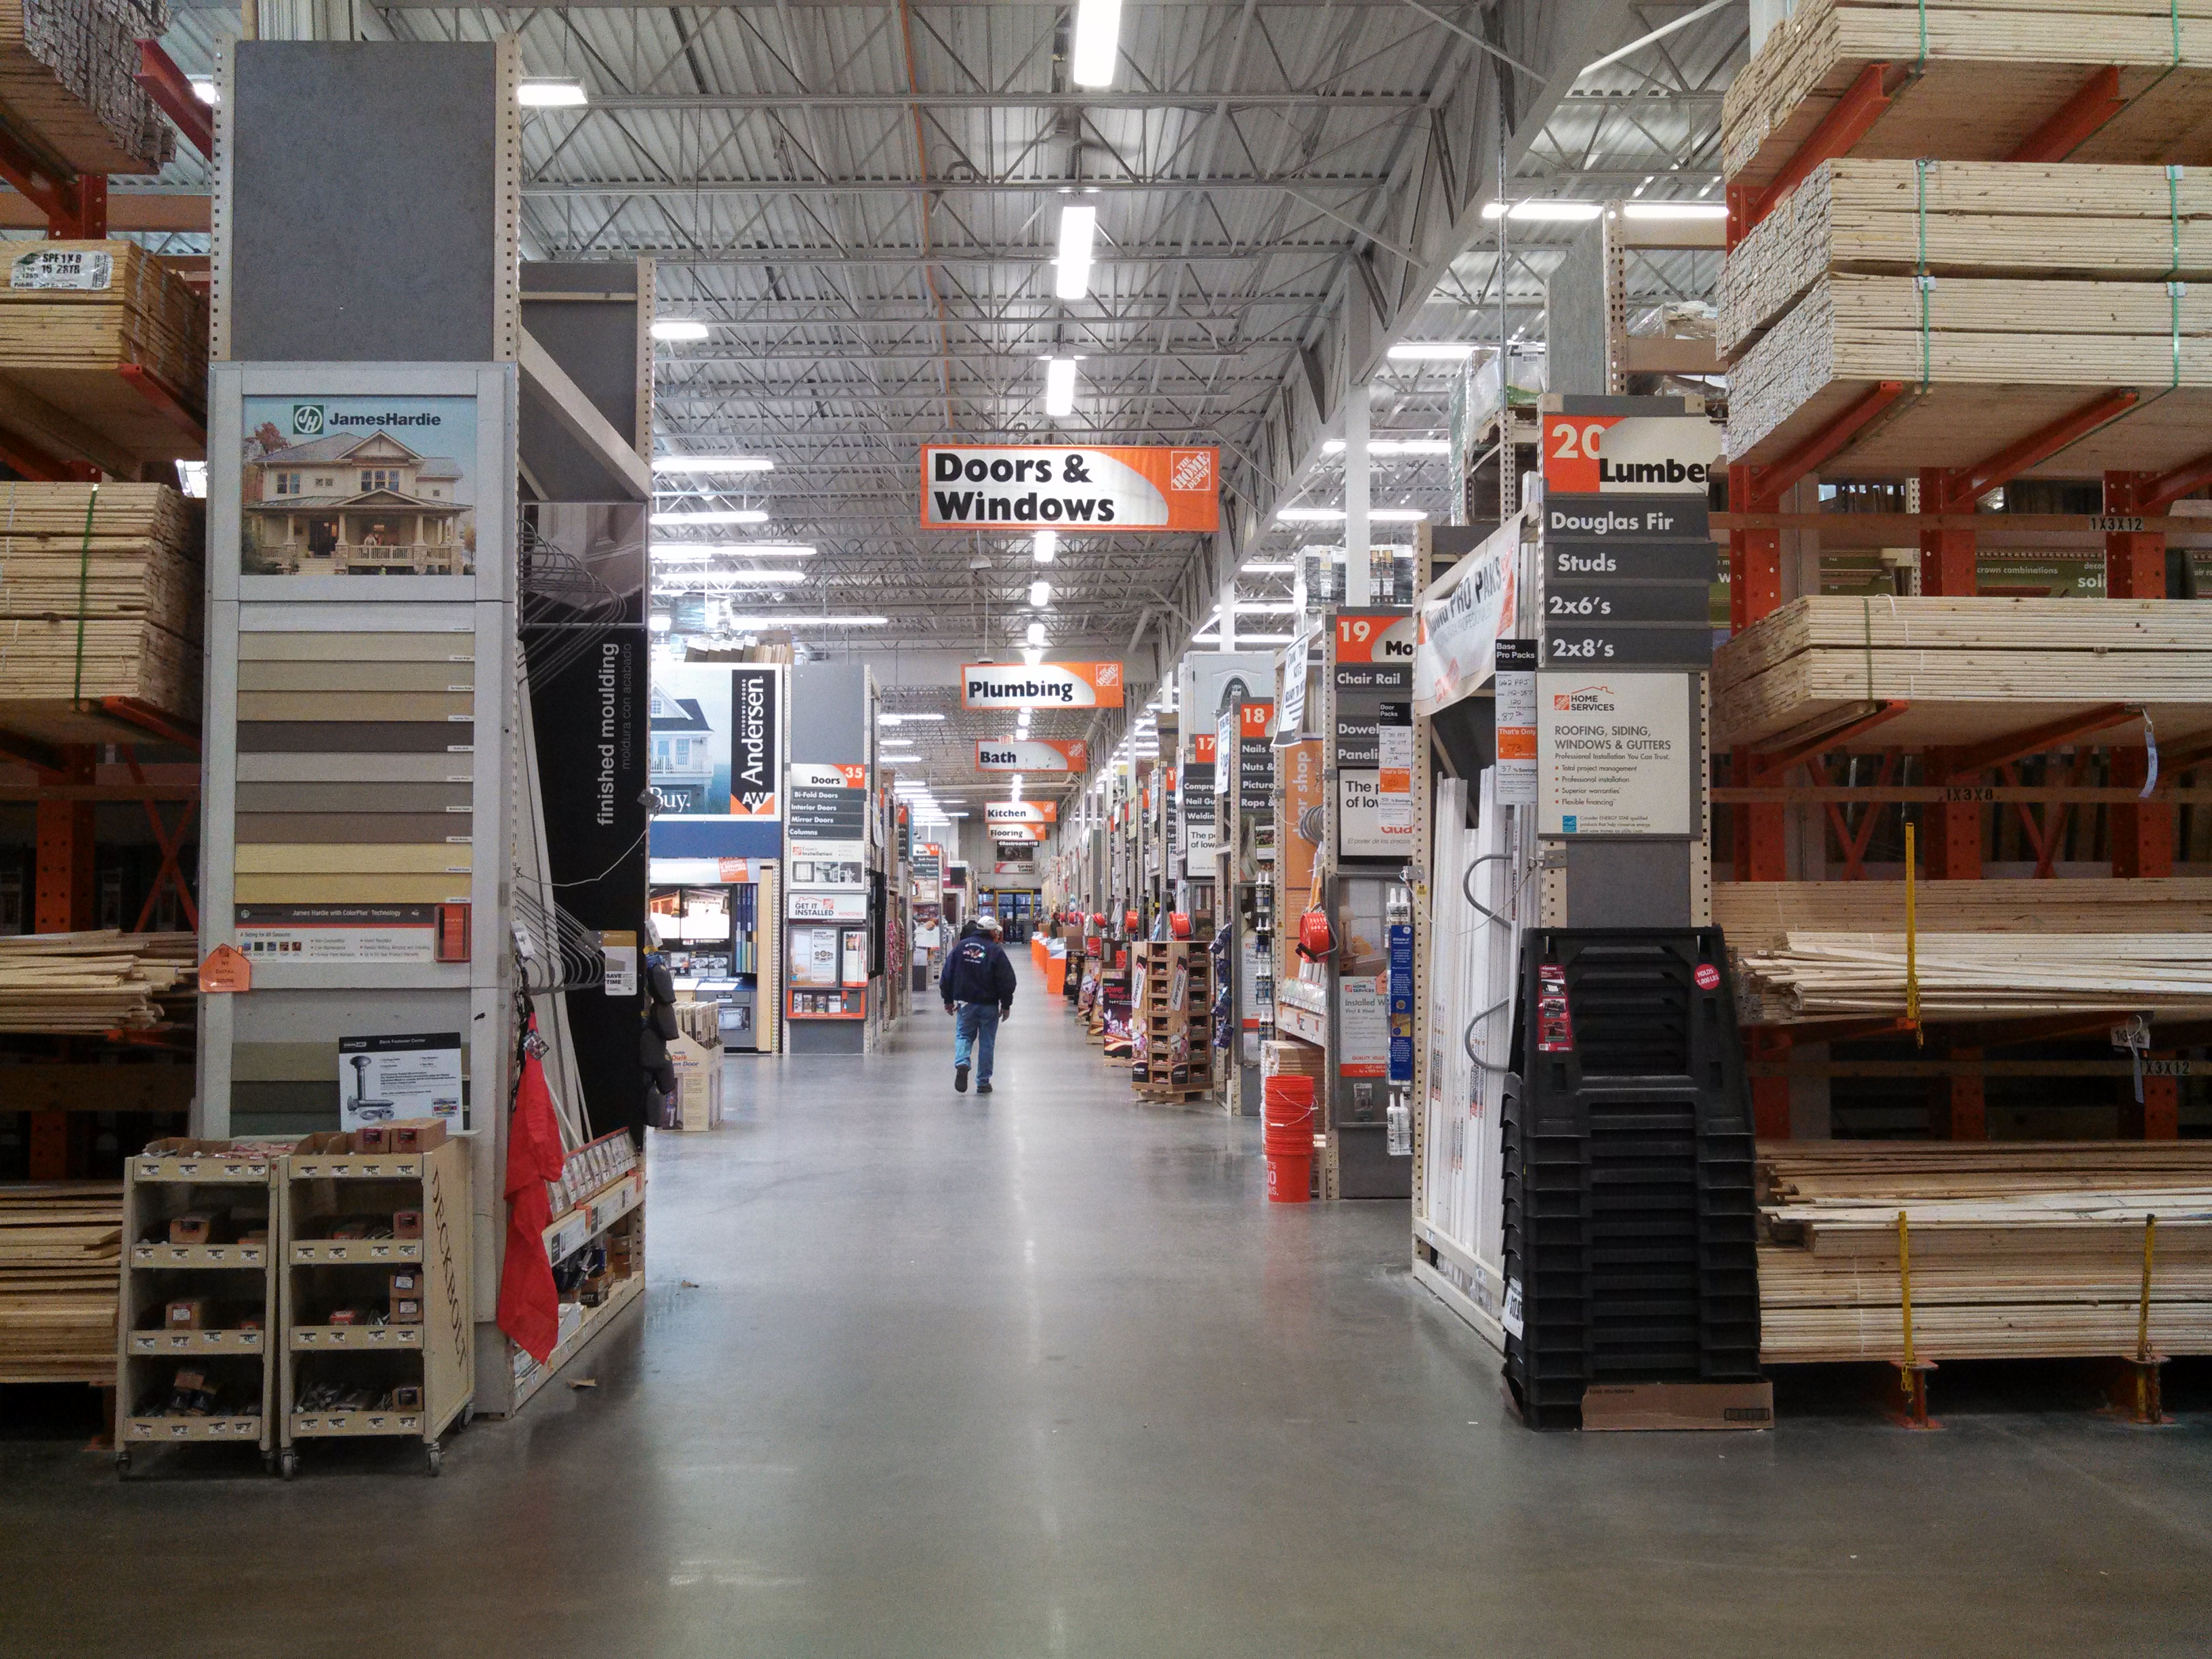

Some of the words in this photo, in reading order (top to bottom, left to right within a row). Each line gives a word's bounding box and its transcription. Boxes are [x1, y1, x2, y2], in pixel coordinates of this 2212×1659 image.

[329, 413, 441, 426] JamesHardie
[1552, 424, 1605, 459] 20
[935, 453, 1052, 483] Doors
[1063, 454, 1094, 483] &
[1172, 453, 1210, 490] HOME
[1188, 468, 1209, 490] DEPOT
[934, 491, 1115, 523] Windows
[1551, 511, 1639, 535] Douglas
[1647, 512, 1674, 530] Fir
[2091, 518, 2143, 531] 1X3X12
[1558, 553, 1617, 571] Studs
[2003, 566, 2058, 575] combinations
[1450, 577, 1472, 617] PRO
[1549, 596, 1612, 615] 2x6's
[1340, 621, 1370, 642] 19
[1553, 639, 1615, 657] 2x8's
[621, 643, 632, 693] acabado
[1337, 673, 1372, 684] Chair
[1376, 673, 1401, 684] Rail
[598, 644, 619, 737] moulding
[969, 680, 1073, 702] Plumbing
[622, 697, 631, 719] con
[1244, 708, 1265, 724] 18
[1521, 729, 1536, 737] Only
[1555, 726, 1607, 737] ROOFING,
[1612, 726, 1651, 737] SIDING,
[621, 722, 631, 770] moldura
[1198, 737, 1216, 750] 17
[1242, 745, 1266, 753] Nails
[1555, 740, 1612, 750] WINDOWS
[1615, 741, 1623, 750] &
[1626, 740, 1671, 750] GUTTERS
[980, 752, 1017, 763] Bath
[845, 767, 863, 779] 35
[1292, 752, 1312, 792] shop
[597, 745, 614, 826] finished
[811, 776, 840, 785] Doors
[1243, 781, 1274, 789] Picture
[1346, 781, 1371, 792] The
[1242, 799, 1265, 808] Rope
[1346, 796, 1359, 808] of
[987, 809, 1026, 817] Kitchen
[990, 830, 1023, 838] Flooring
[1354, 838, 1370, 846] poder
[371, 909, 401, 918] Technology
[1697, 968, 1715, 978] HOLDS
[1711, 974, 1719, 983] LBS
[1173, 972, 1182, 1004] Energizer
[1345, 998, 1376, 1006] Installed
